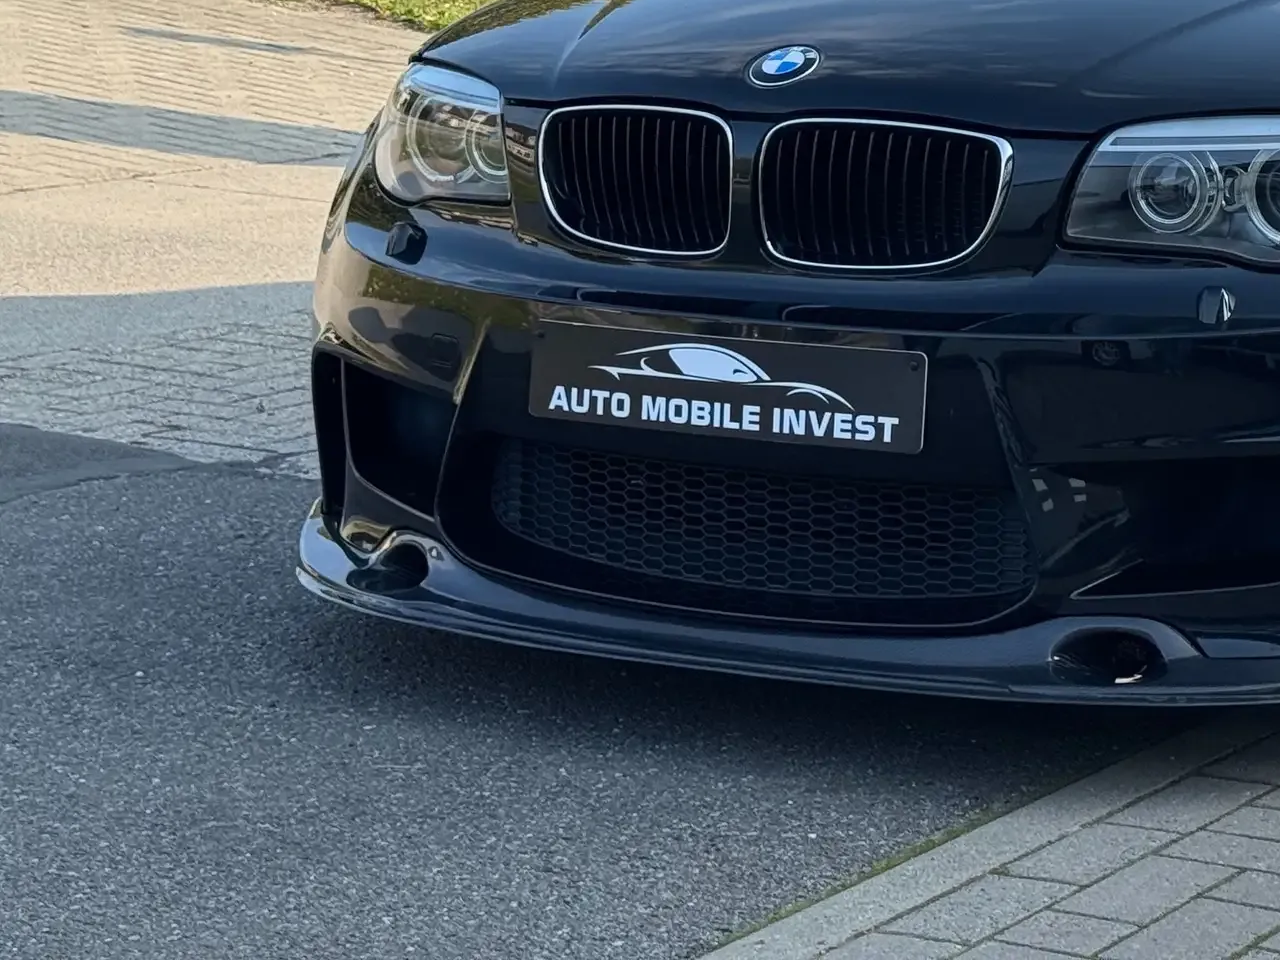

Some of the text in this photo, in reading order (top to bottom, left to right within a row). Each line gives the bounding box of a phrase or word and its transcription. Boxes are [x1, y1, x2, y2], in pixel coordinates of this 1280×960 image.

[548, 385, 900, 443] AUTO MOBILE INVEST
